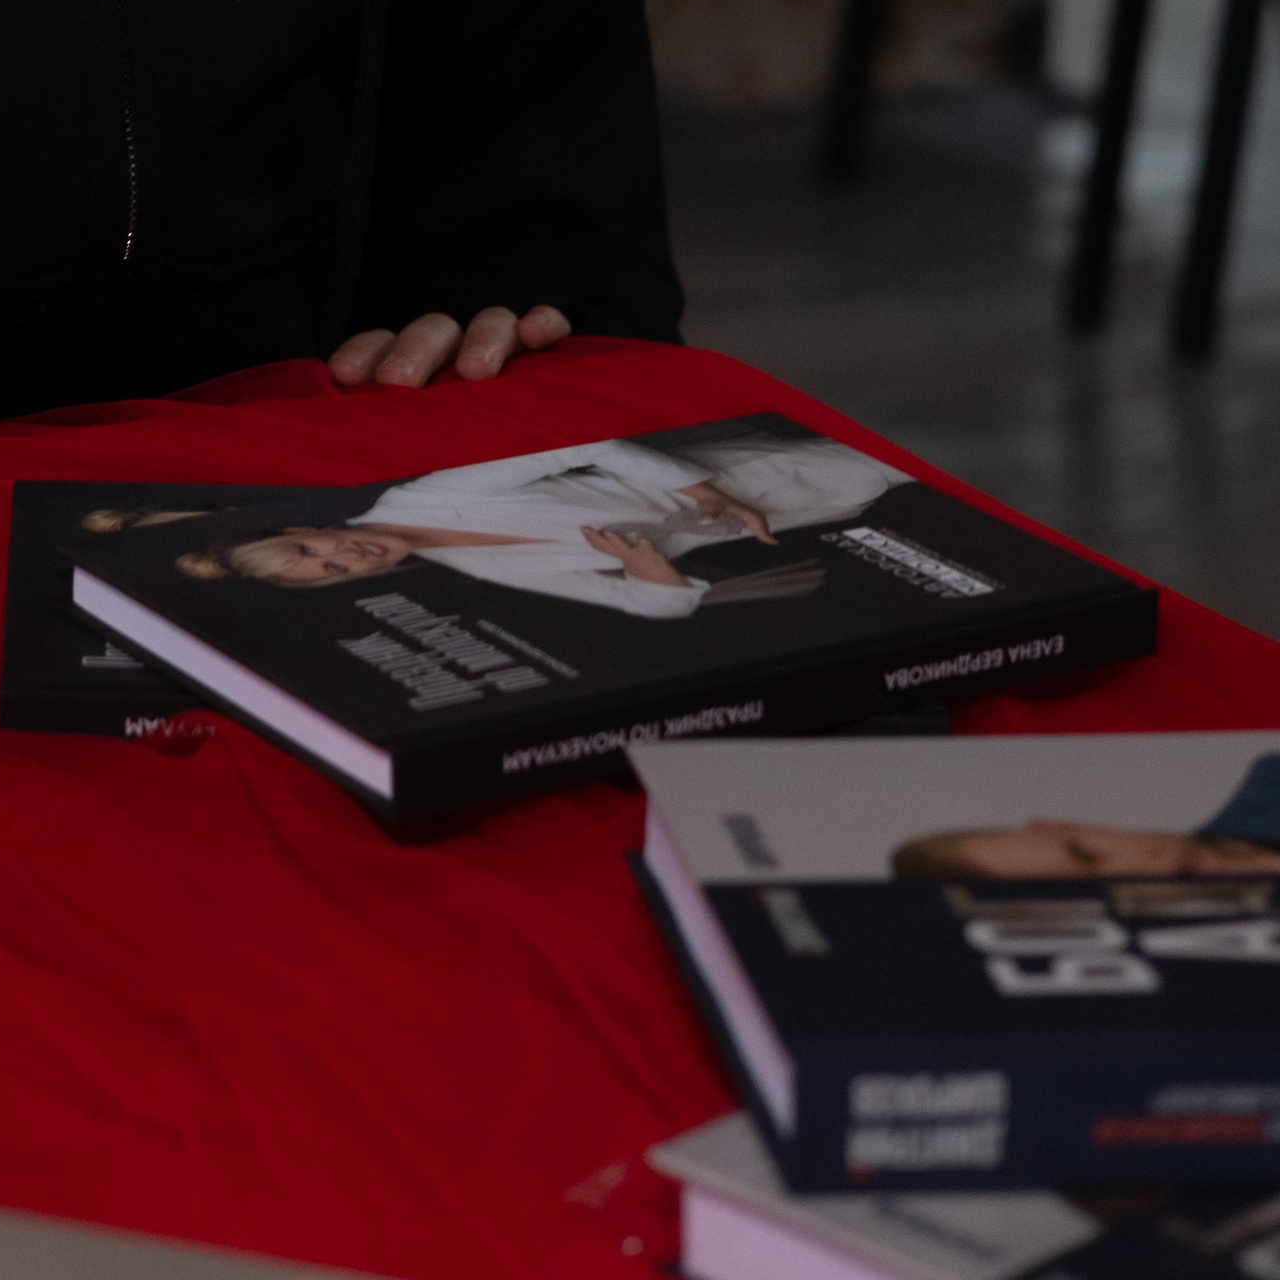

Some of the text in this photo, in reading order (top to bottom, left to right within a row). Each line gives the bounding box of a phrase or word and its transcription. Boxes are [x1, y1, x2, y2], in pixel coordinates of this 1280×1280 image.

[884, 633, 1065, 691] ЕЛЕНА БЕРДНИКОВА
[662, 698, 764, 736] ПРАЗДНИК
[501, 726, 626, 774] МОЛЕКУЛАМ
